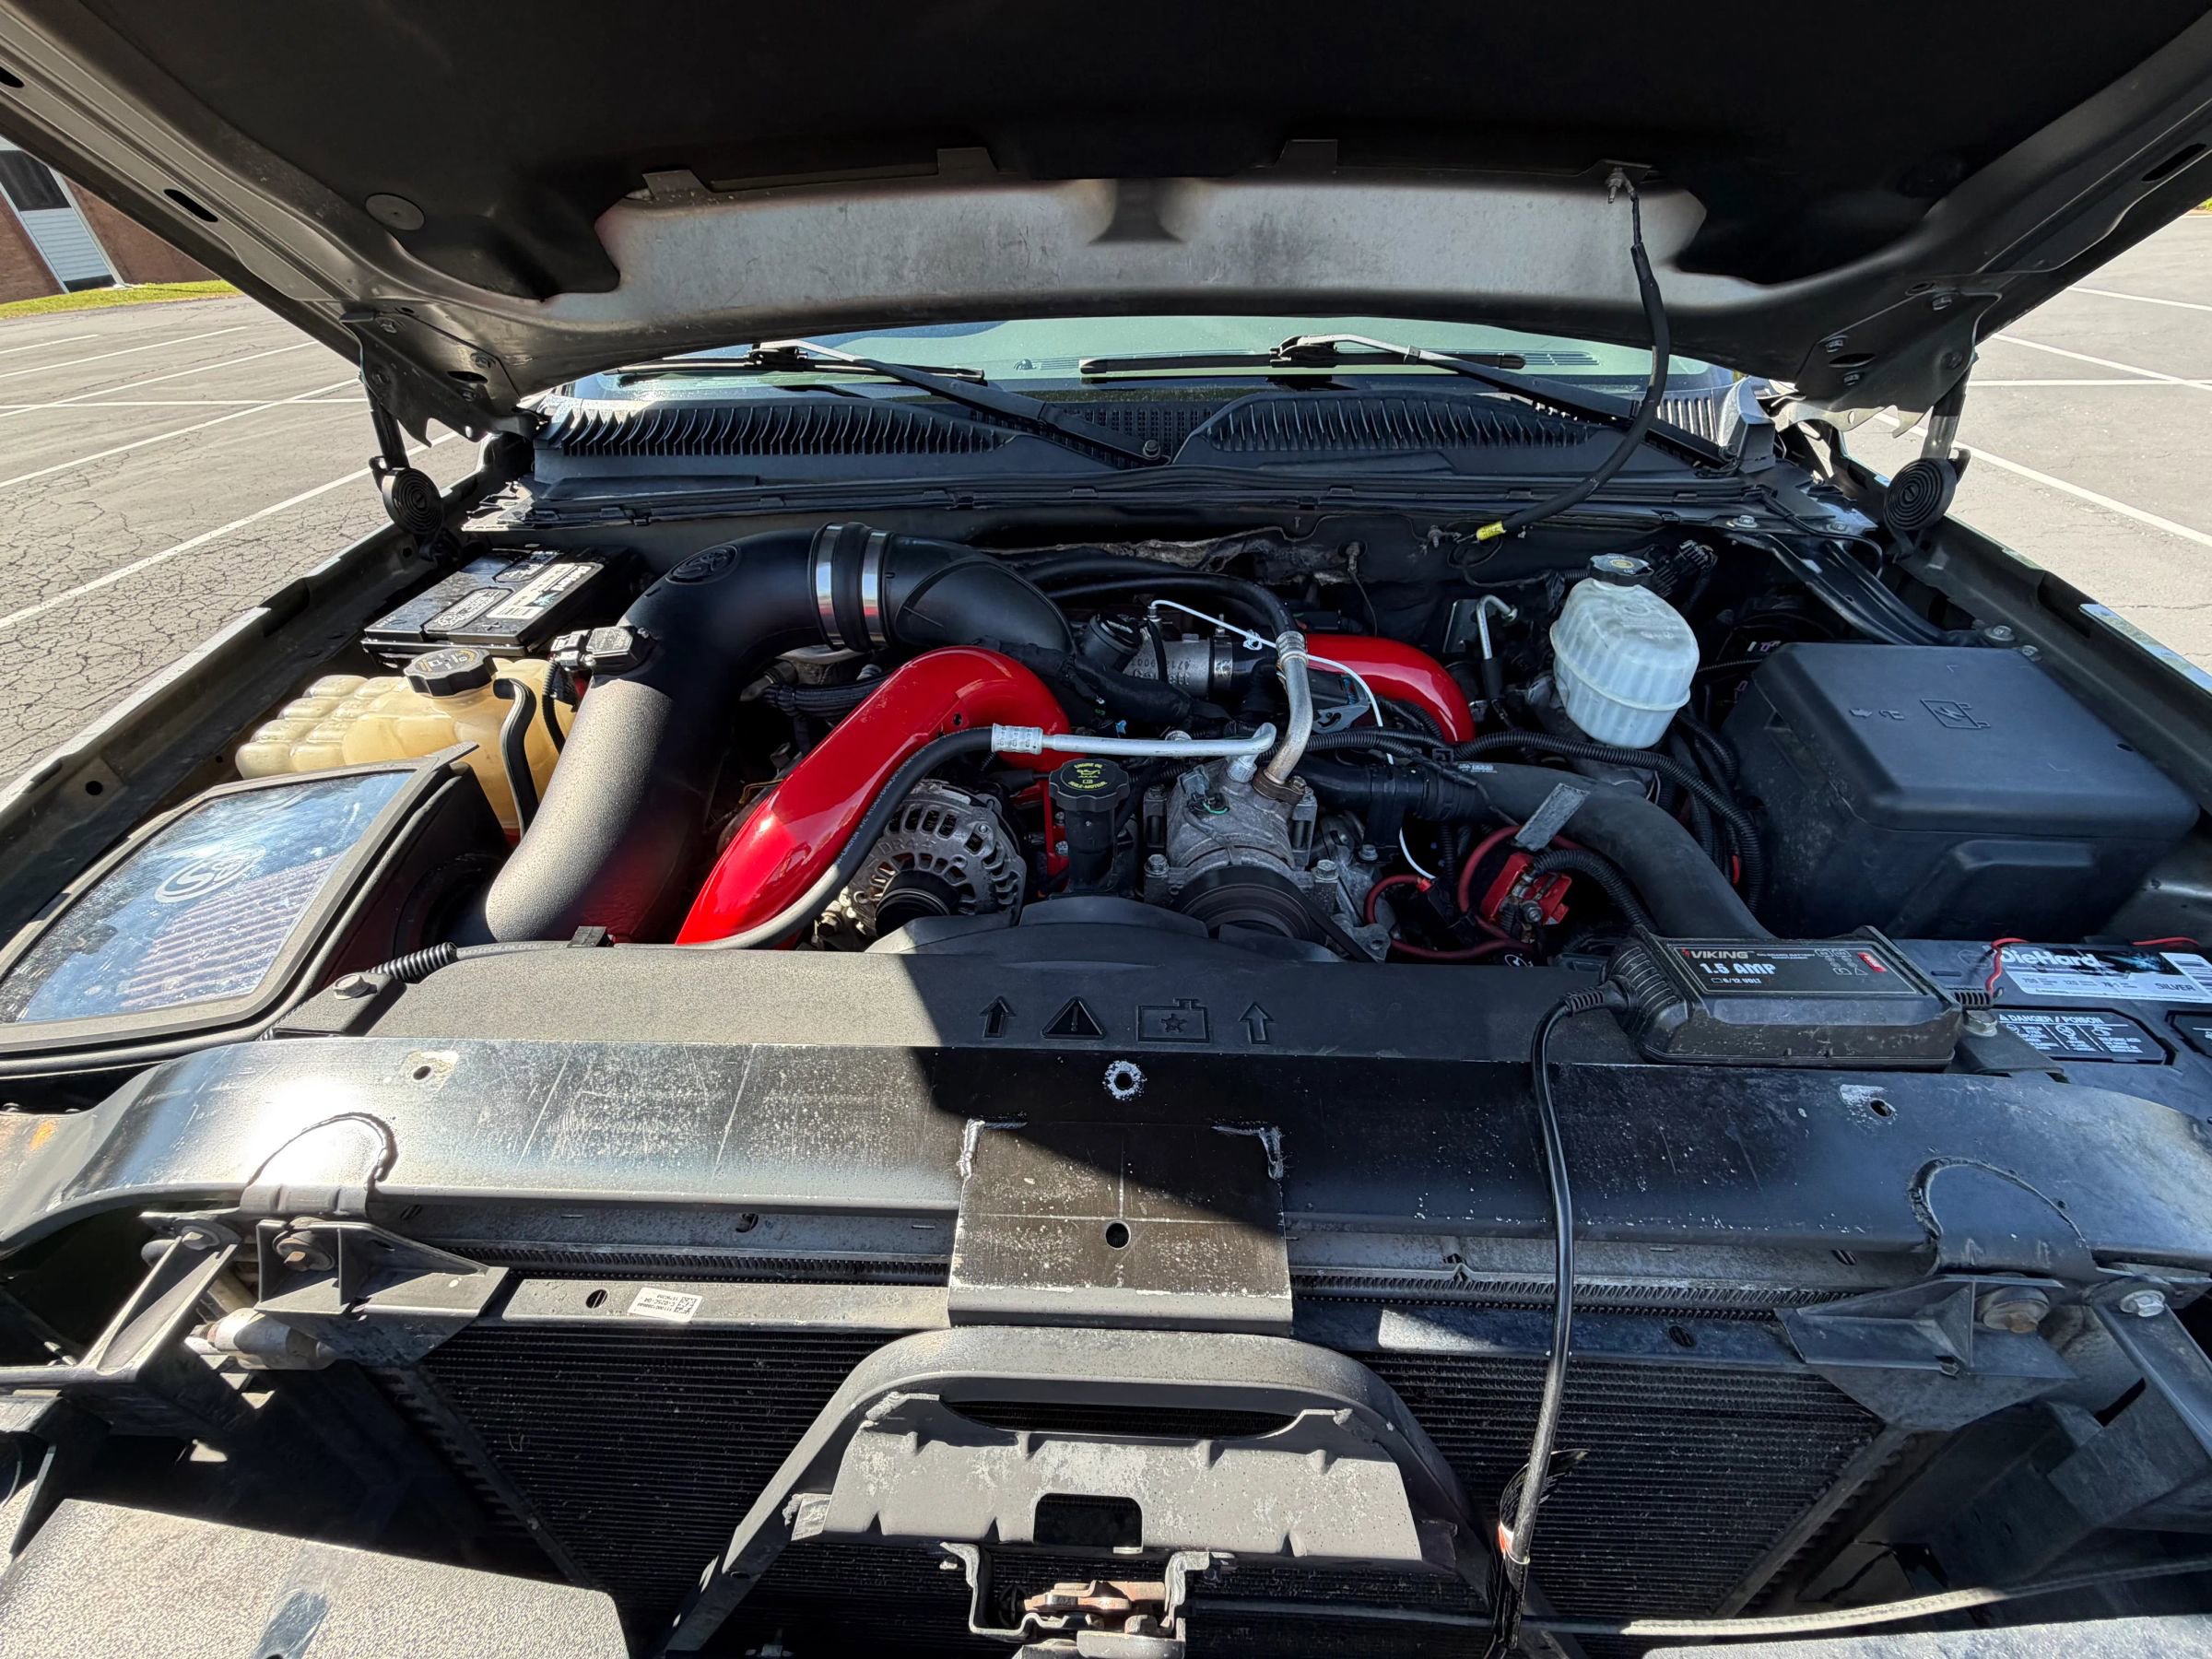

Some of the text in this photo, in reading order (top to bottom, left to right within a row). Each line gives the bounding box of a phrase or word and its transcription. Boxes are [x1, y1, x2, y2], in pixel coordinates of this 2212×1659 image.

[1691, 950, 1750, 959] VIKING
[2000, 949, 2101, 968] DieHard
[1700, 963, 1776, 975] 1.5 AMP
[2154, 982, 2196, 992] SILVER
[2008, 1015, 2053, 1023] DANGER
[2063, 1016, 2105, 1025] POISON
